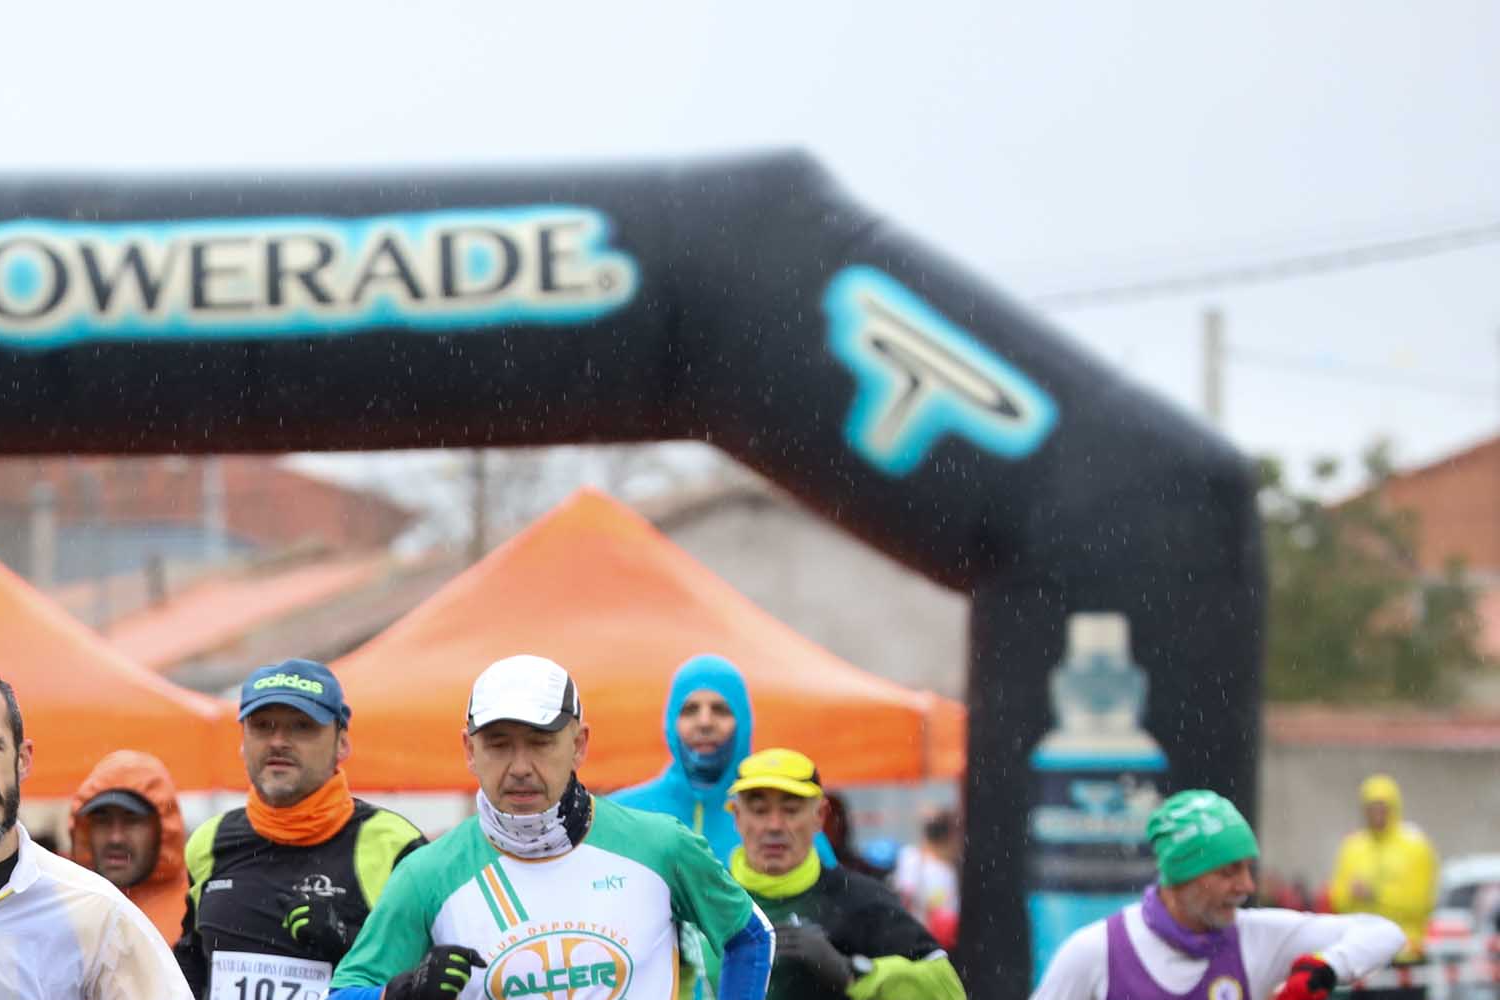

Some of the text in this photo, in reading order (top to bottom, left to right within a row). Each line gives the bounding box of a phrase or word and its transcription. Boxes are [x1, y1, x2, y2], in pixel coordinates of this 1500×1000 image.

[253, 673, 323, 694] adidas
[487, 921, 629, 959] LUB DEPORTIVO
[501, 961, 617, 999] ALCER
